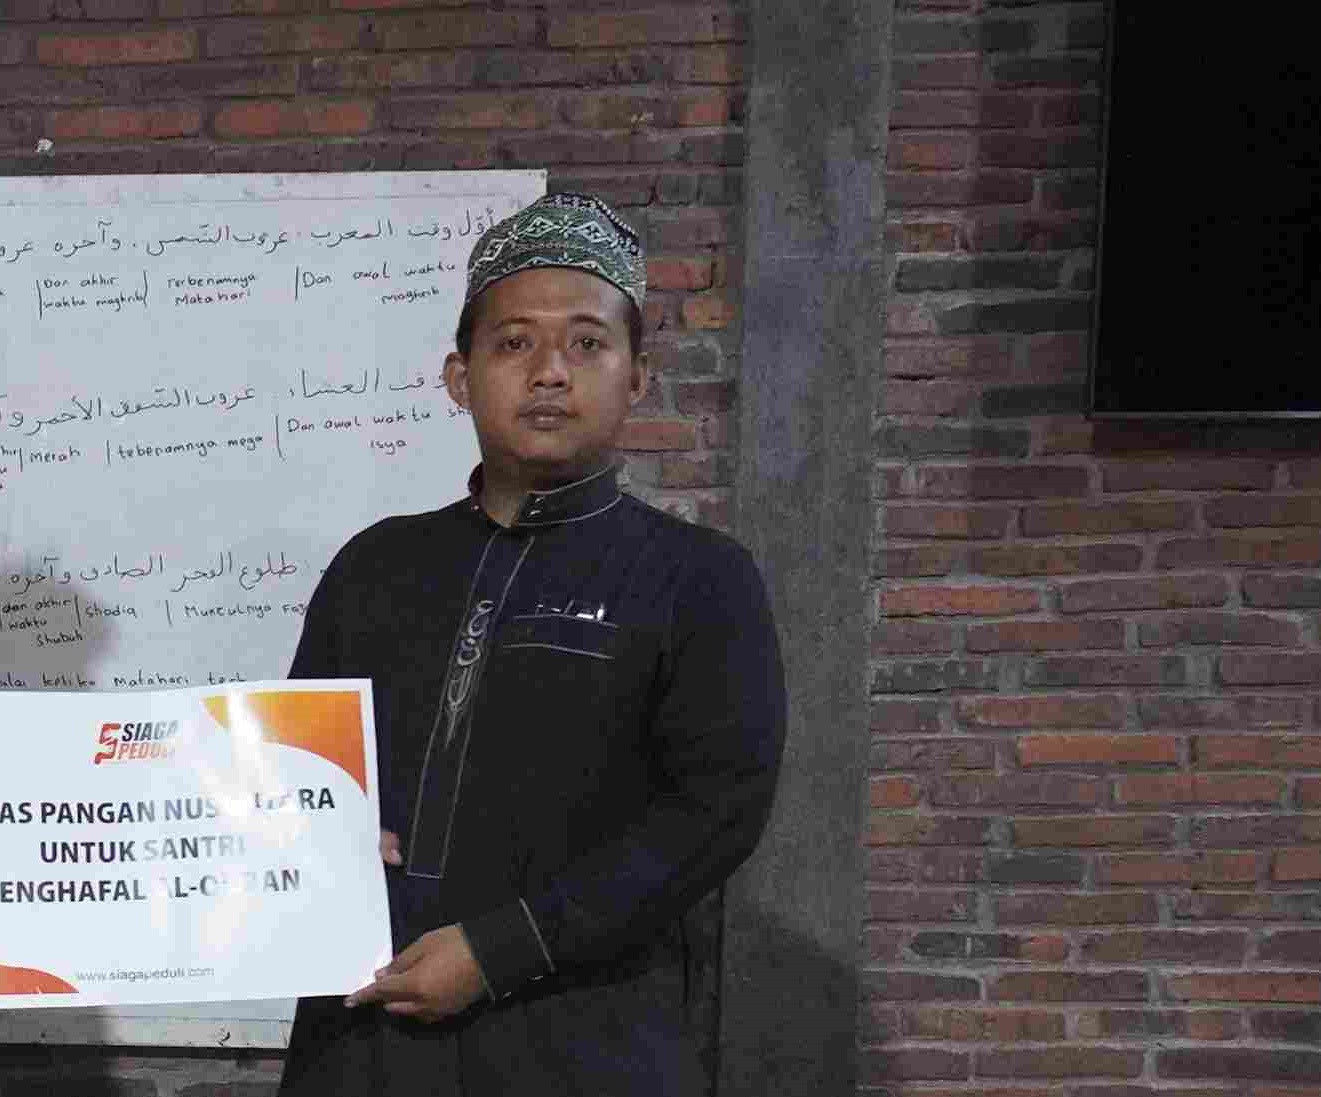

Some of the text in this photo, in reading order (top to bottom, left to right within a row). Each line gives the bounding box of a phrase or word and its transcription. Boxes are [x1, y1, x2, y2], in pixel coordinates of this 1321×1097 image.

[40, 798, 156, 825] PANGAN
[39, 834, 248, 864] UNTUK SANTRI
